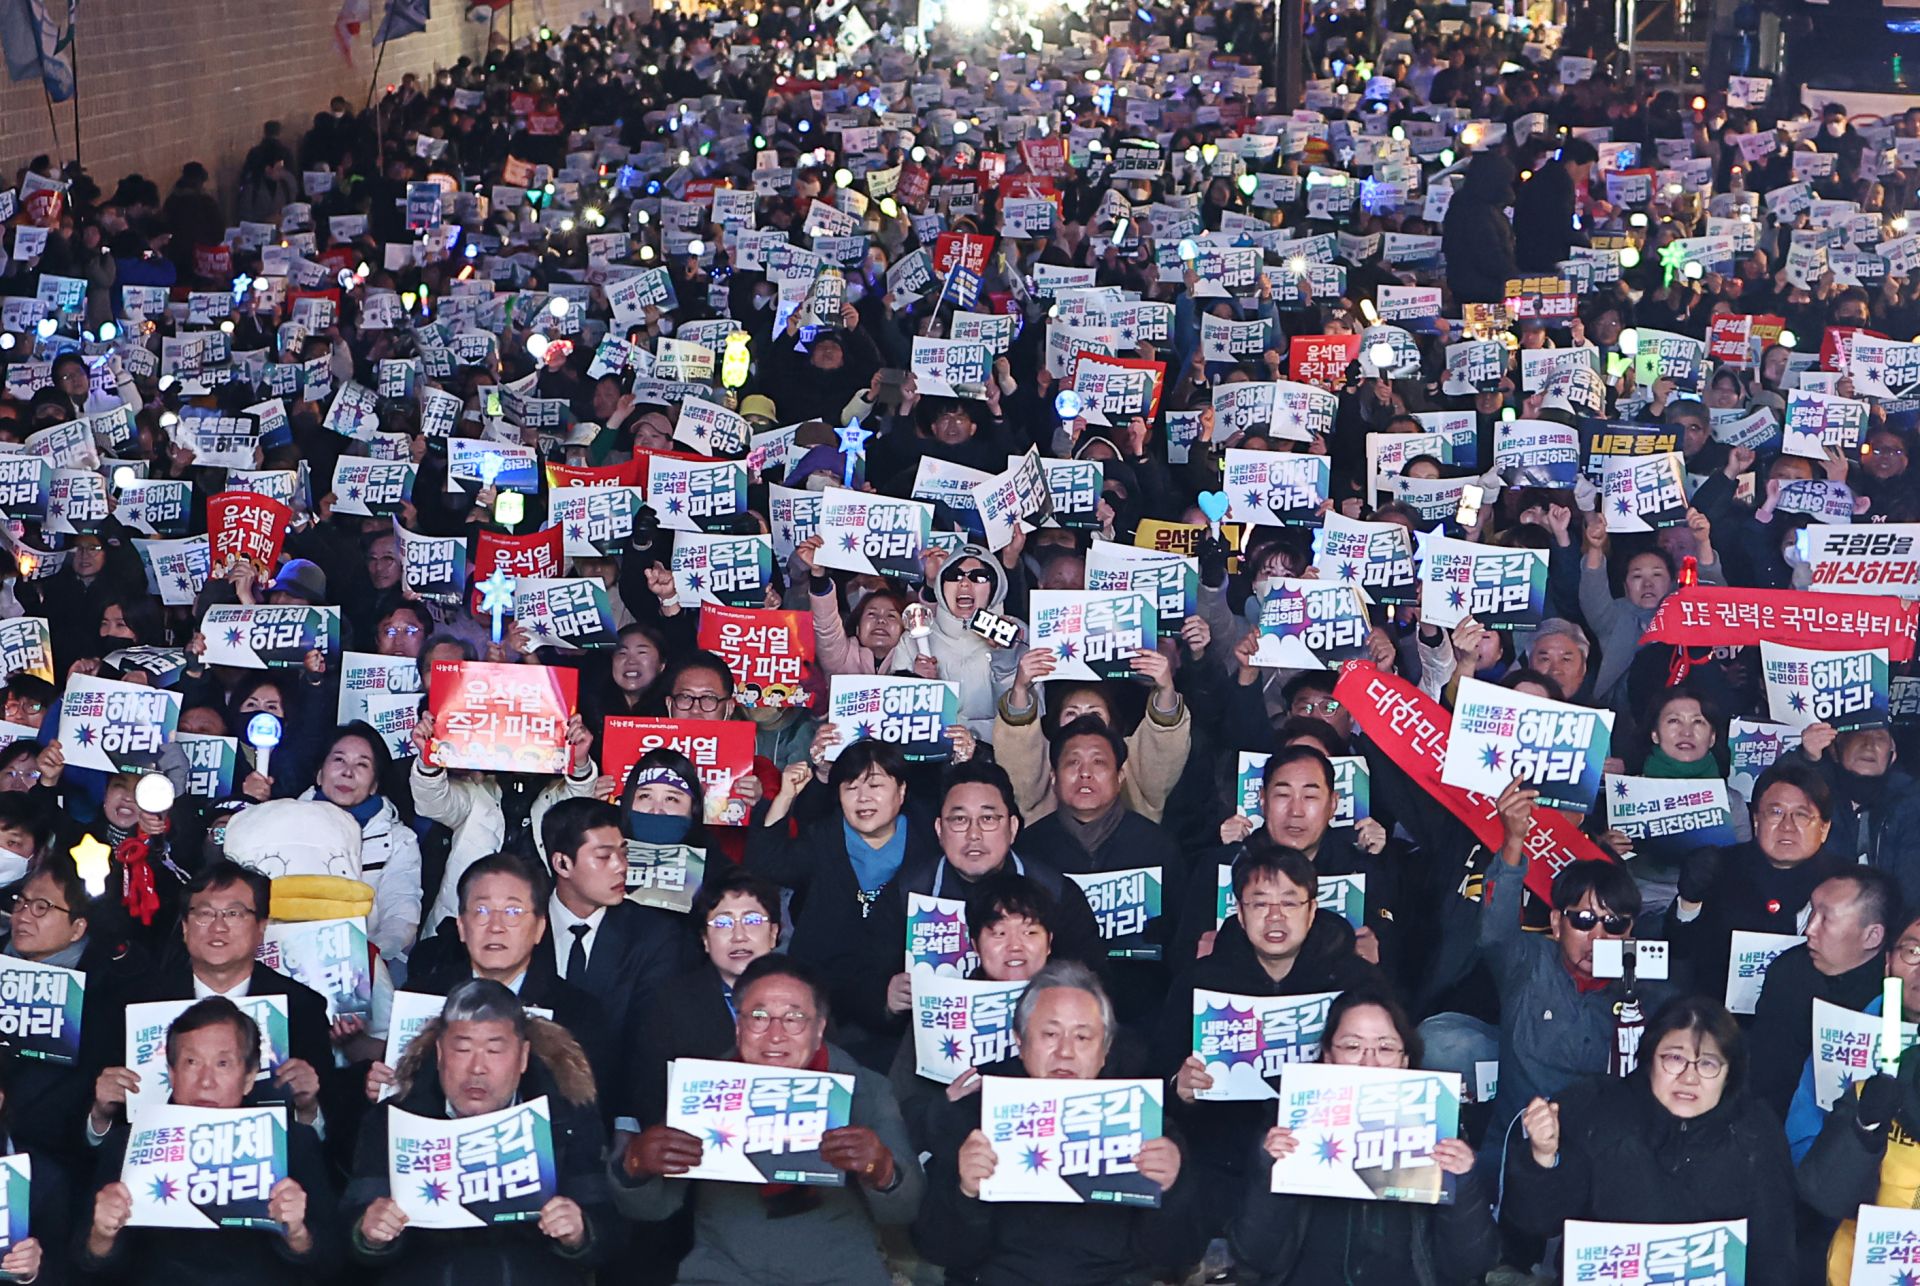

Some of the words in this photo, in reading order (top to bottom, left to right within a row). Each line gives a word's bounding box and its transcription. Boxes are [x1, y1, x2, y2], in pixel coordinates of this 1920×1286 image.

[1223, 248, 1257, 268] 즉각
[815, 279, 842, 298] 해체
[1223, 269, 1256, 287] 파면
[814, 296, 841, 315] 하라
[1138, 306, 1168, 324] 즉각
[1400, 304, 1439, 320] 퇴진하라!
[981, 316, 1013, 341] 즉각
[1137, 322, 1168, 342] 파면
[1231, 323, 1265, 341] 즉각
[915, 346, 945, 357] 내란동조
[946, 345, 984, 366] 해체
[1230, 338, 1264, 354] 파면
[1307, 345, 1347, 362] 윤석열
[1468, 342, 1501, 363] 즉각
[1659, 338, 1696, 359] 해체
[915, 355, 945, 365] 국민의힘
[1300, 361, 1327, 378] 즉각
[1657, 357, 1691, 378] 하라
[945, 364, 983, 384] 하라
[1079, 372, 1106, 383] 내란수괴
[1469, 361, 1501, 383] 파면
[377, 380, 407, 398] 파면
[1077, 381, 1104, 394] 윤석열
[1106, 373, 1146, 396] 즉각
[1103, 392, 1143, 415] 파면
[1236, 385, 1276, 409] 해체
[1309, 392, 1338, 413] 즉각
[96, 406, 129, 432] 해체
[1235, 405, 1272, 427] 하라
[1306, 411, 1333, 434] 파면
[1791, 406, 1825, 417] 내란수괴
[1791, 415, 1824, 429] 윤석열
[1825, 403, 1864, 426] 즉각
[50, 423, 84, 447] 즉각
[1497, 436, 1536, 451] 내란수괴
[1538, 434, 1573, 446] 윤석열은
[1591, 434, 1635, 456] 내란
[1638, 434, 1677, 455] 종식
[1823, 425, 1858, 449] 파면
[0, 459, 41, 483] 해체
[369, 464, 409, 483] 즉각
[689, 464, 737, 493] 즉각
[1051, 463, 1096, 491] 즉각
[1268, 458, 1319, 487] 해체
[147, 482, 182, 503] 해체
[589, 489, 633, 516] 즉각
[1052, 492, 1094, 514] 파면
[1635, 485, 1682, 516] 파면
[689, 491, 736, 518] 파면
[222, 505, 275, 536] 윤석열
[588, 514, 633, 541] 파면
[868, 502, 919, 533] 해체
[864, 532, 917, 560] 하라
[1328, 530, 1368, 545] 내란수괴
[1824, 533, 1914, 556] 국힘당을
[407, 540, 456, 563] 해체
[709, 538, 760, 567] 즉각
[1325, 541, 1366, 559] 윤석열
[1431, 554, 1472, 567] 내란수괴
[406, 560, 454, 586] 하라
[710, 562, 761, 593] 파면
[1090, 569, 1129, 581] 내란수괴
[1364, 559, 1415, 588] 파면
[1431, 566, 1470, 583] 윤석열
[1474, 549, 1535, 586] 즉각
[1811, 561, 1920, 585] 해산하라!
[548, 581, 596, 614] 즉각
[1306, 586, 1361, 620] 해체
[1470, 579, 1531, 615] 파면
[254, 607, 309, 624] 해체
[1037, 604, 1083, 620] 내란수괴
[1085, 594, 1147, 632] 즉각
[1681, 601, 1711, 627] 모든
[1715, 602, 1776, 629] 권력은
[1780, 606, 1890, 637] 국민으로부터
[1, 621, 41, 648] 즉각
[553, 609, 603, 639] 파면
[974, 610, 1019, 647] 파면
[1037, 617, 1082, 639] 윤석열
[1304, 617, 1364, 651] 하라
[250, 624, 303, 651] 하라
[718, 621, 789, 652] 윤석열
[1083, 628, 1145, 663] 파면
[3, 646, 45, 674] 파면
[753, 652, 803, 683] 파면
[1767, 661, 1808, 674] 내란동조
[1811, 653, 1872, 690] 해체
[346, 677, 385, 690] 국민의힘
[1769, 673, 1809, 686] 국민의힘
[107, 691, 168, 724] 해체
[464, 680, 543, 713] 윤석열
[836, 688, 881, 705] 내란동조
[884, 684, 945, 715] 해체
[1813, 688, 1874, 720] 하라
[835, 701, 880, 717] 국민의힘
[1461, 704, 1517, 722] 내란동조
[101, 723, 163, 755] 하라
[446, 712, 498, 741] 즉각
[502, 714, 556, 746] 파면
[881, 713, 942, 744] 하라
[1460, 719, 1515, 737] 국민의힘
[1518, 709, 1597, 750] 해체
[1735, 740, 1778, 753] 내란수괴
[1511, 748, 1587, 785] 하라
[1735, 752, 1776, 767] 윤석열
[1613, 800, 1660, 817] 내란수괴
[1664, 790, 1714, 809] 윤석열은
[1649, 807, 1724, 837] 퇴진하라!
[1085, 872, 1147, 912] 해체
[912, 921, 960, 937] 내란수괴
[911, 935, 961, 955] 윤석열
[2, 970, 68, 1005] 해체
[920, 995, 968, 1010] 내란수괴
[921, 1010, 967, 1029] 윤석열
[1202, 1018, 1257, 1035] 내란수괴
[1201, 1032, 1256, 1055] 윤석열
[1821, 1028, 1870, 1046] 내란수괴
[1821, 1045, 1868, 1067] 윤석열
[683, 1078, 746, 1093] 내란수괴
[749, 1076, 833, 1112] 즉각
[1291, 1086, 1353, 1107] 내란수괴
[682, 1091, 744, 1116] 윤석열
[993, 1100, 1057, 1119] 내란수괴
[1357, 1077, 1442, 1126] 즉각
[1063, 1086, 1143, 1141] 즉각
[1290, 1104, 1352, 1129] 윤석열
[133, 1126, 186, 1148] 내란동조
[189, 1113, 273, 1166] 해체
[456, 1111, 535, 1168] 즉각
[744, 1110, 827, 1155] 파면
[993, 1118, 1056, 1142] 윤석열
[129, 1145, 186, 1166] 국민의힘
[396, 1138, 451, 1154] 내란수괴
[1060, 1136, 1143, 1178] 파면
[1354, 1124, 1438, 1171] 파면
[395, 1150, 452, 1174] 윤석열
[187, 1165, 273, 1206] 하라
[457, 1158, 541, 1205] 파면
[1576, 1243, 1641, 1261] 내란수괴
[1645, 1228, 1729, 1276] 즉각
[1576, 1259, 1640, 1281] 윤석열
